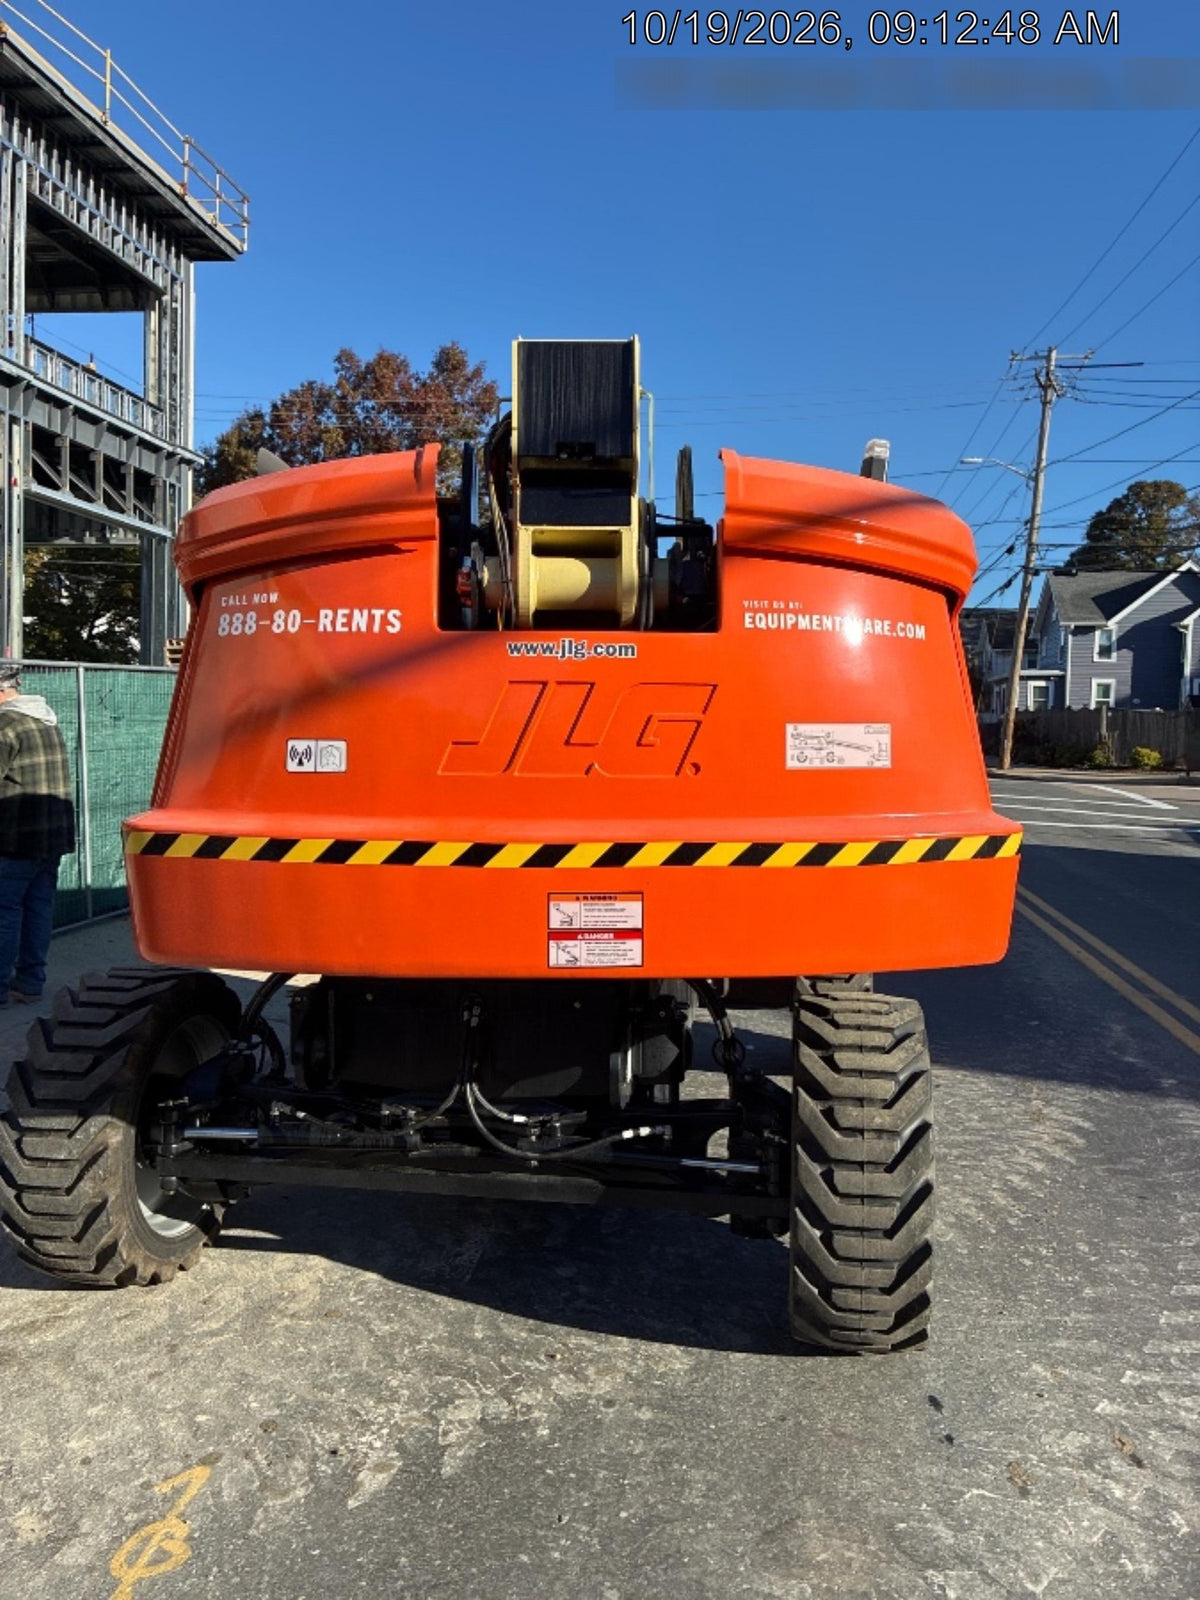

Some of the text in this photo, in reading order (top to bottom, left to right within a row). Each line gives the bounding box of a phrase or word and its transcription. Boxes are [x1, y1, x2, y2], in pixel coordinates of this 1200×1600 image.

[221, 591, 280, 607] CALL NOW
[742, 600, 769, 609] VISIT
[218, 609, 402, 636] 888-80-RENTS
[744, 613, 925, 640] EQUIPMENTARE.COM
[507, 639, 637, 659] www.jlg.com
